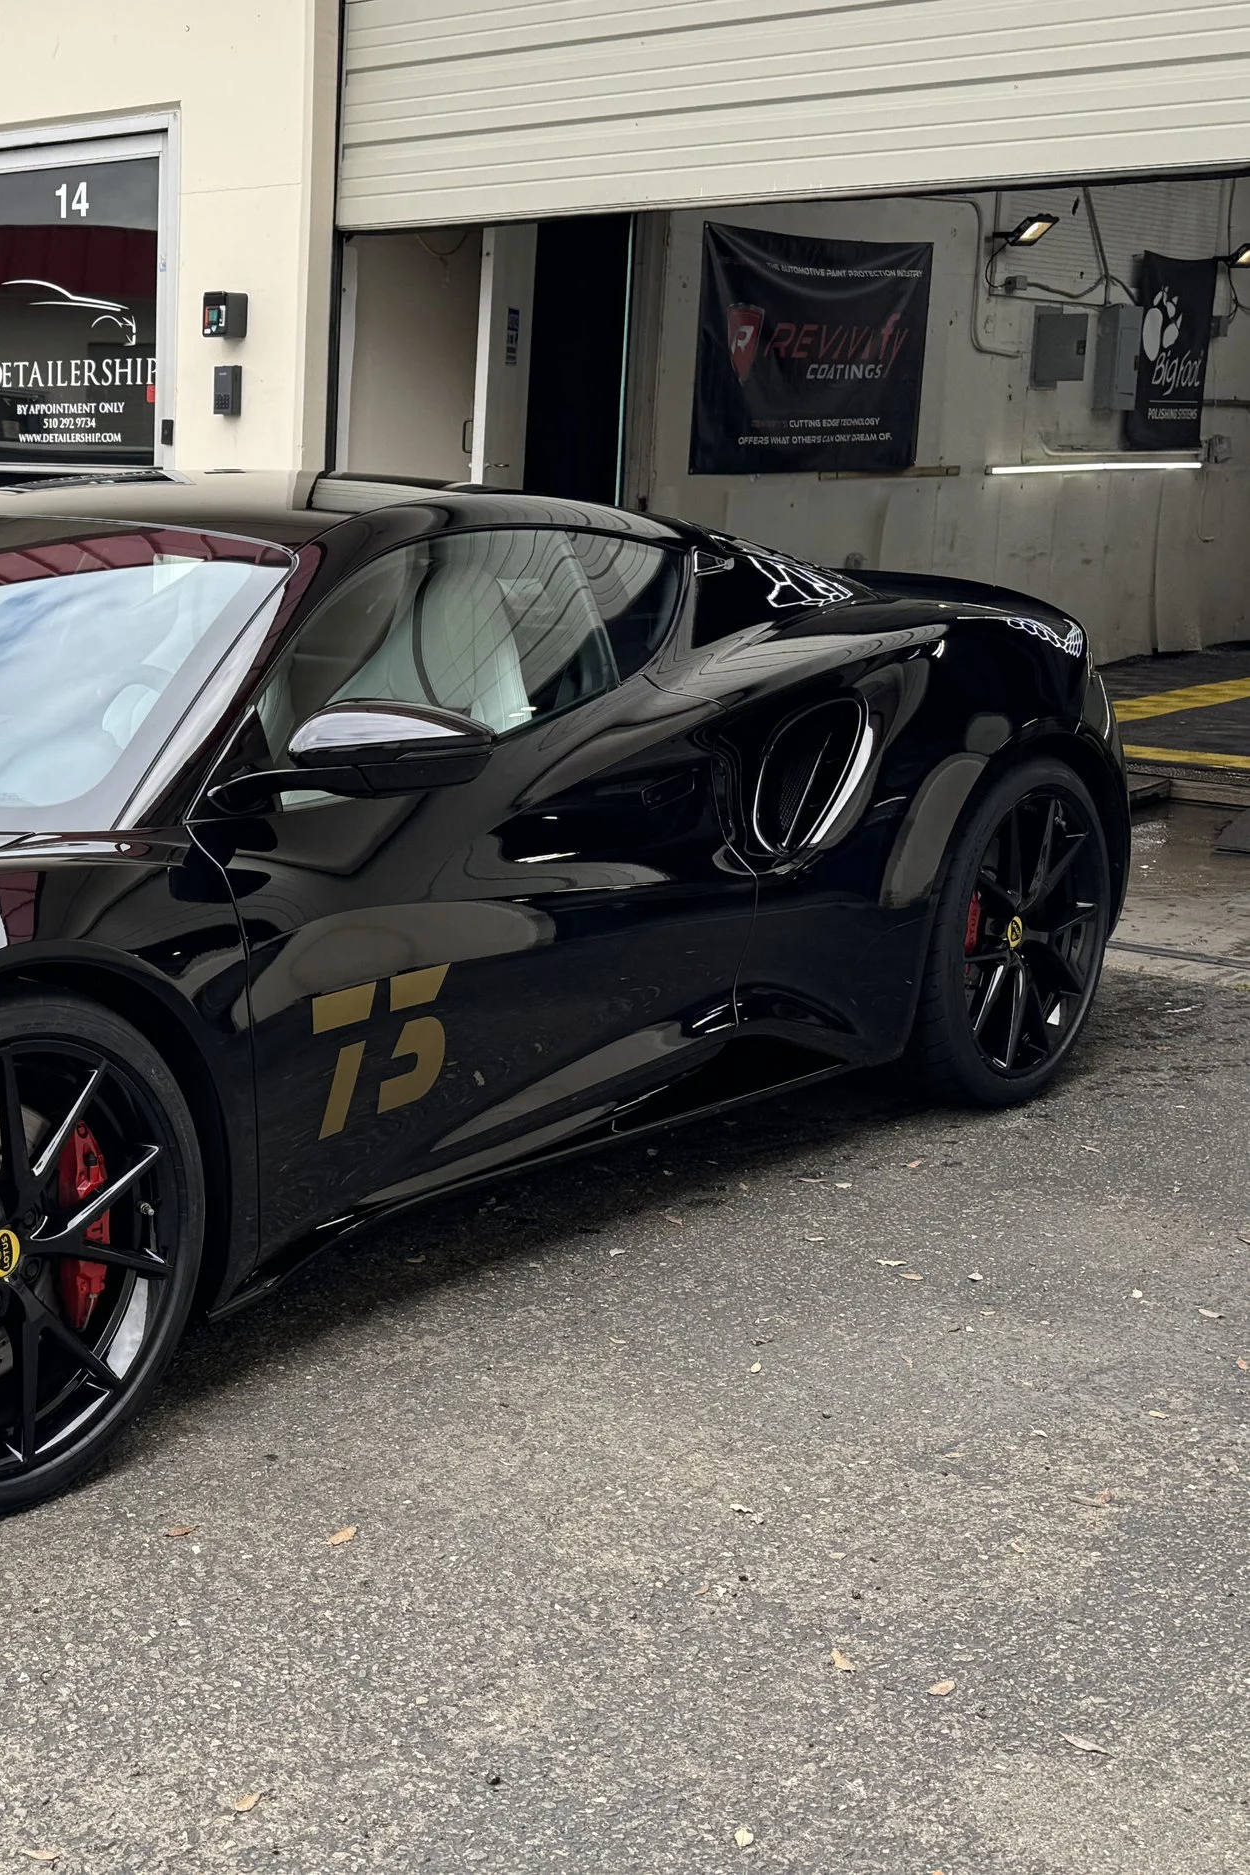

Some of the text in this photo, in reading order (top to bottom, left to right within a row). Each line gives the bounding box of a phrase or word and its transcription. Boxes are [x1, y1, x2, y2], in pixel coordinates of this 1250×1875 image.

[55, 181, 90, 219] 14
[781, 265, 825, 277] AUTOMOTIVE
[826, 269, 847, 278] PAINT
[848, 269, 896, 278] PROTECTION
[805, 363, 884, 380] COATINGS
[16, 402, 125, 416] BY APPOINTMENT ONLY
[43, 417, 96, 429] 510 292 9734
[788, 419, 821, 428] CUTTING
[18, 432, 122, 443] WWW.DETAILERSHIP.COM
[737, 436, 769, 445] OFFERS
[770, 435, 790, 445] WHAT
[791, 435, 822, 444] OTHERS
[834, 434, 851, 442] ONLY
[1, 1236, 10, 1269] LOTUS
